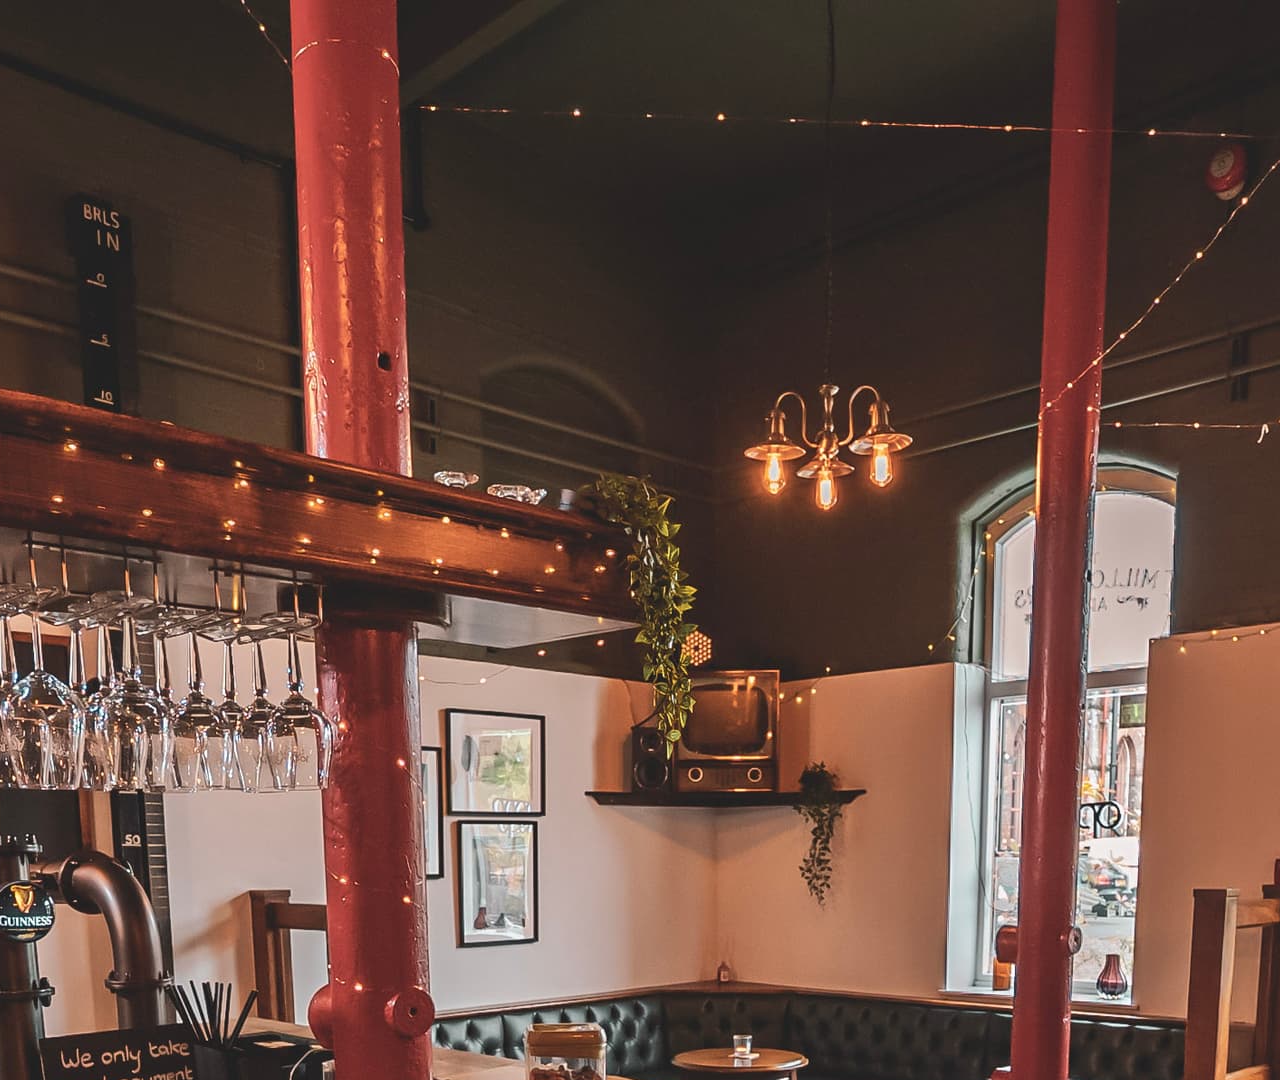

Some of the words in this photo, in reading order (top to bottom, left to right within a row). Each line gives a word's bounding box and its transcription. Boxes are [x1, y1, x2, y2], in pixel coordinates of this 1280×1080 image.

[83, 203, 120, 230] BRLS
[97, 229, 120, 252] IN
[60, 1048, 95, 1069] We
[101, 1044, 142, 1074] only
[148, 1040, 191, 1058] take
